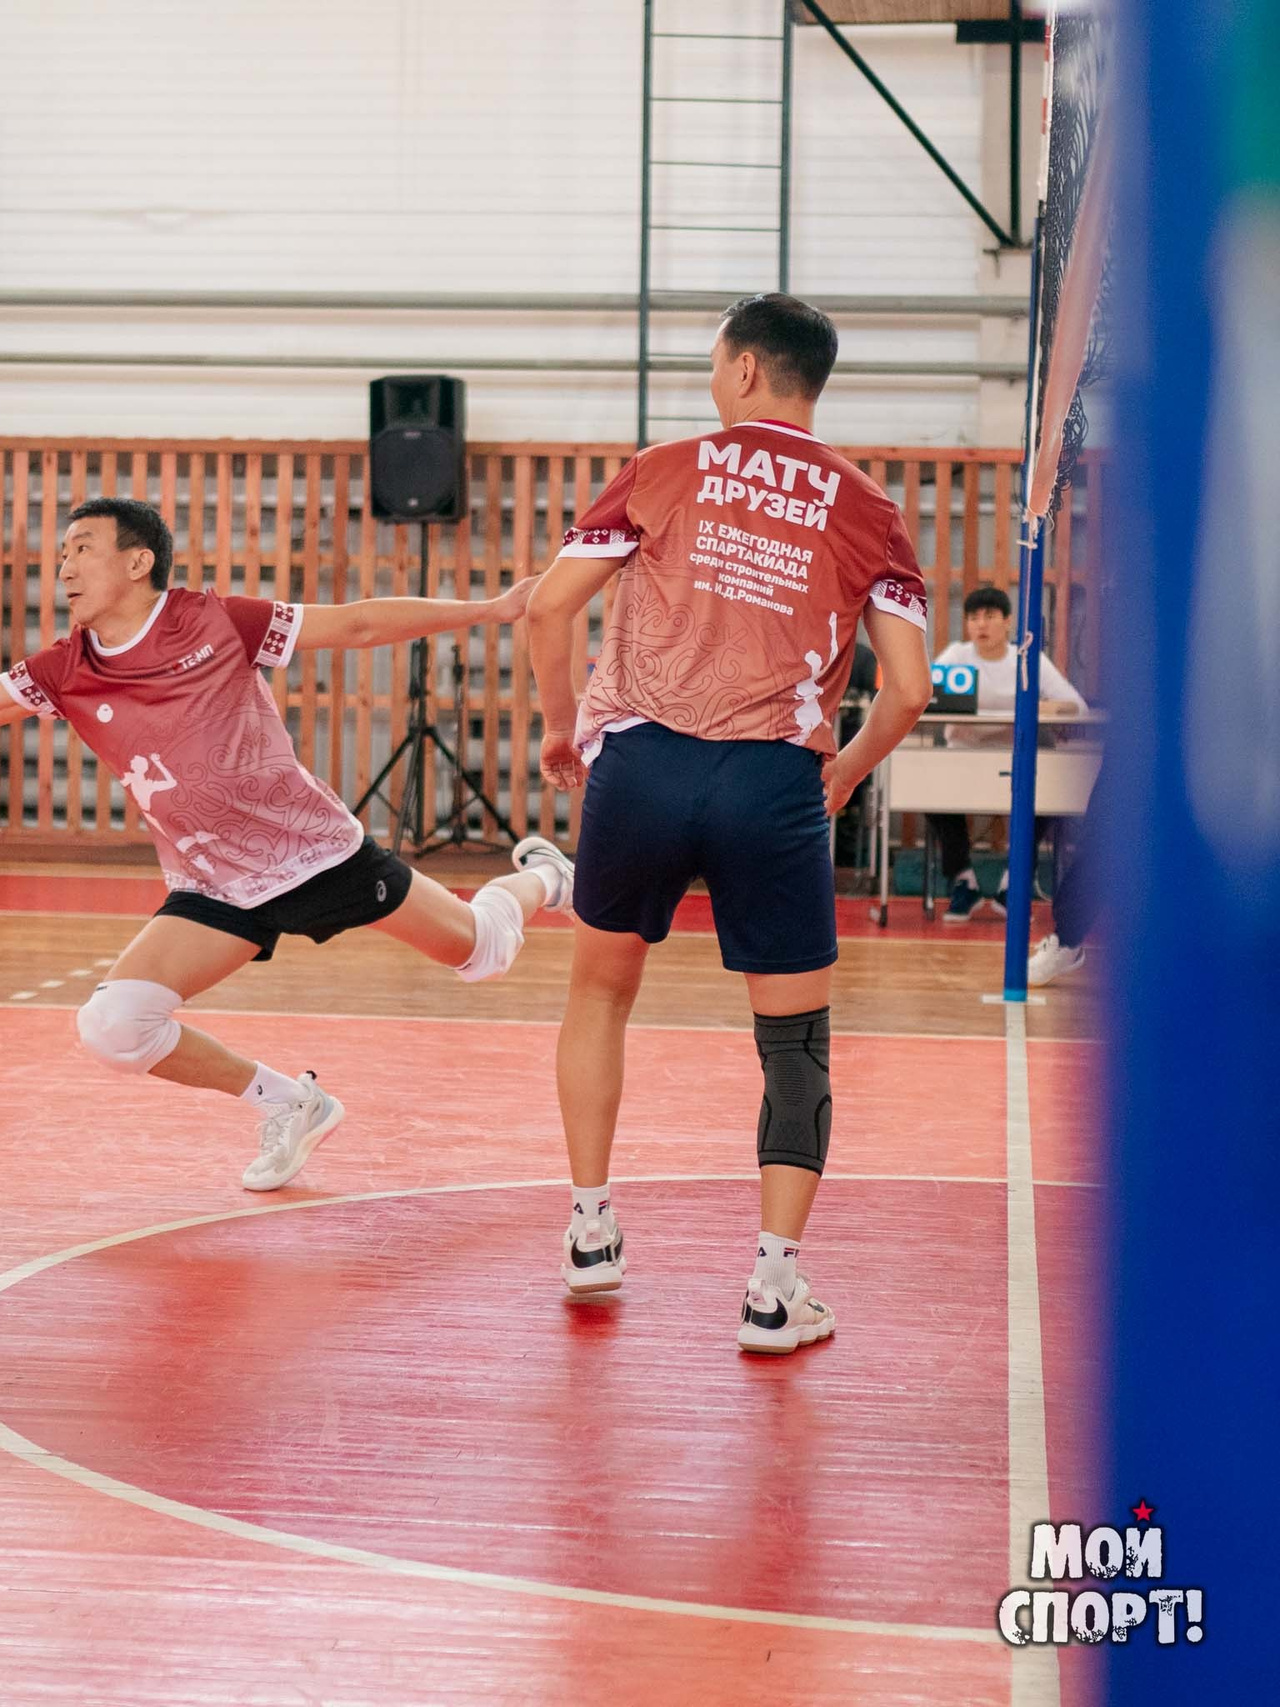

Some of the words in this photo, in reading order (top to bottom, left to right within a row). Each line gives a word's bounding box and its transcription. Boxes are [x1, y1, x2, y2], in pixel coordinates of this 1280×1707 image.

[698, 440, 841, 507] МАТЧ
[696, 475, 828, 531] ДРУЗЕЙ
[696, 536, 808, 579] СПАРТАКИАДА
[698, 519, 716, 535] IX
[718, 523, 813, 563] ЕЖЕГОДНАЯ
[718, 572, 774, 596] компаний
[725, 561, 809, 593] строительных
